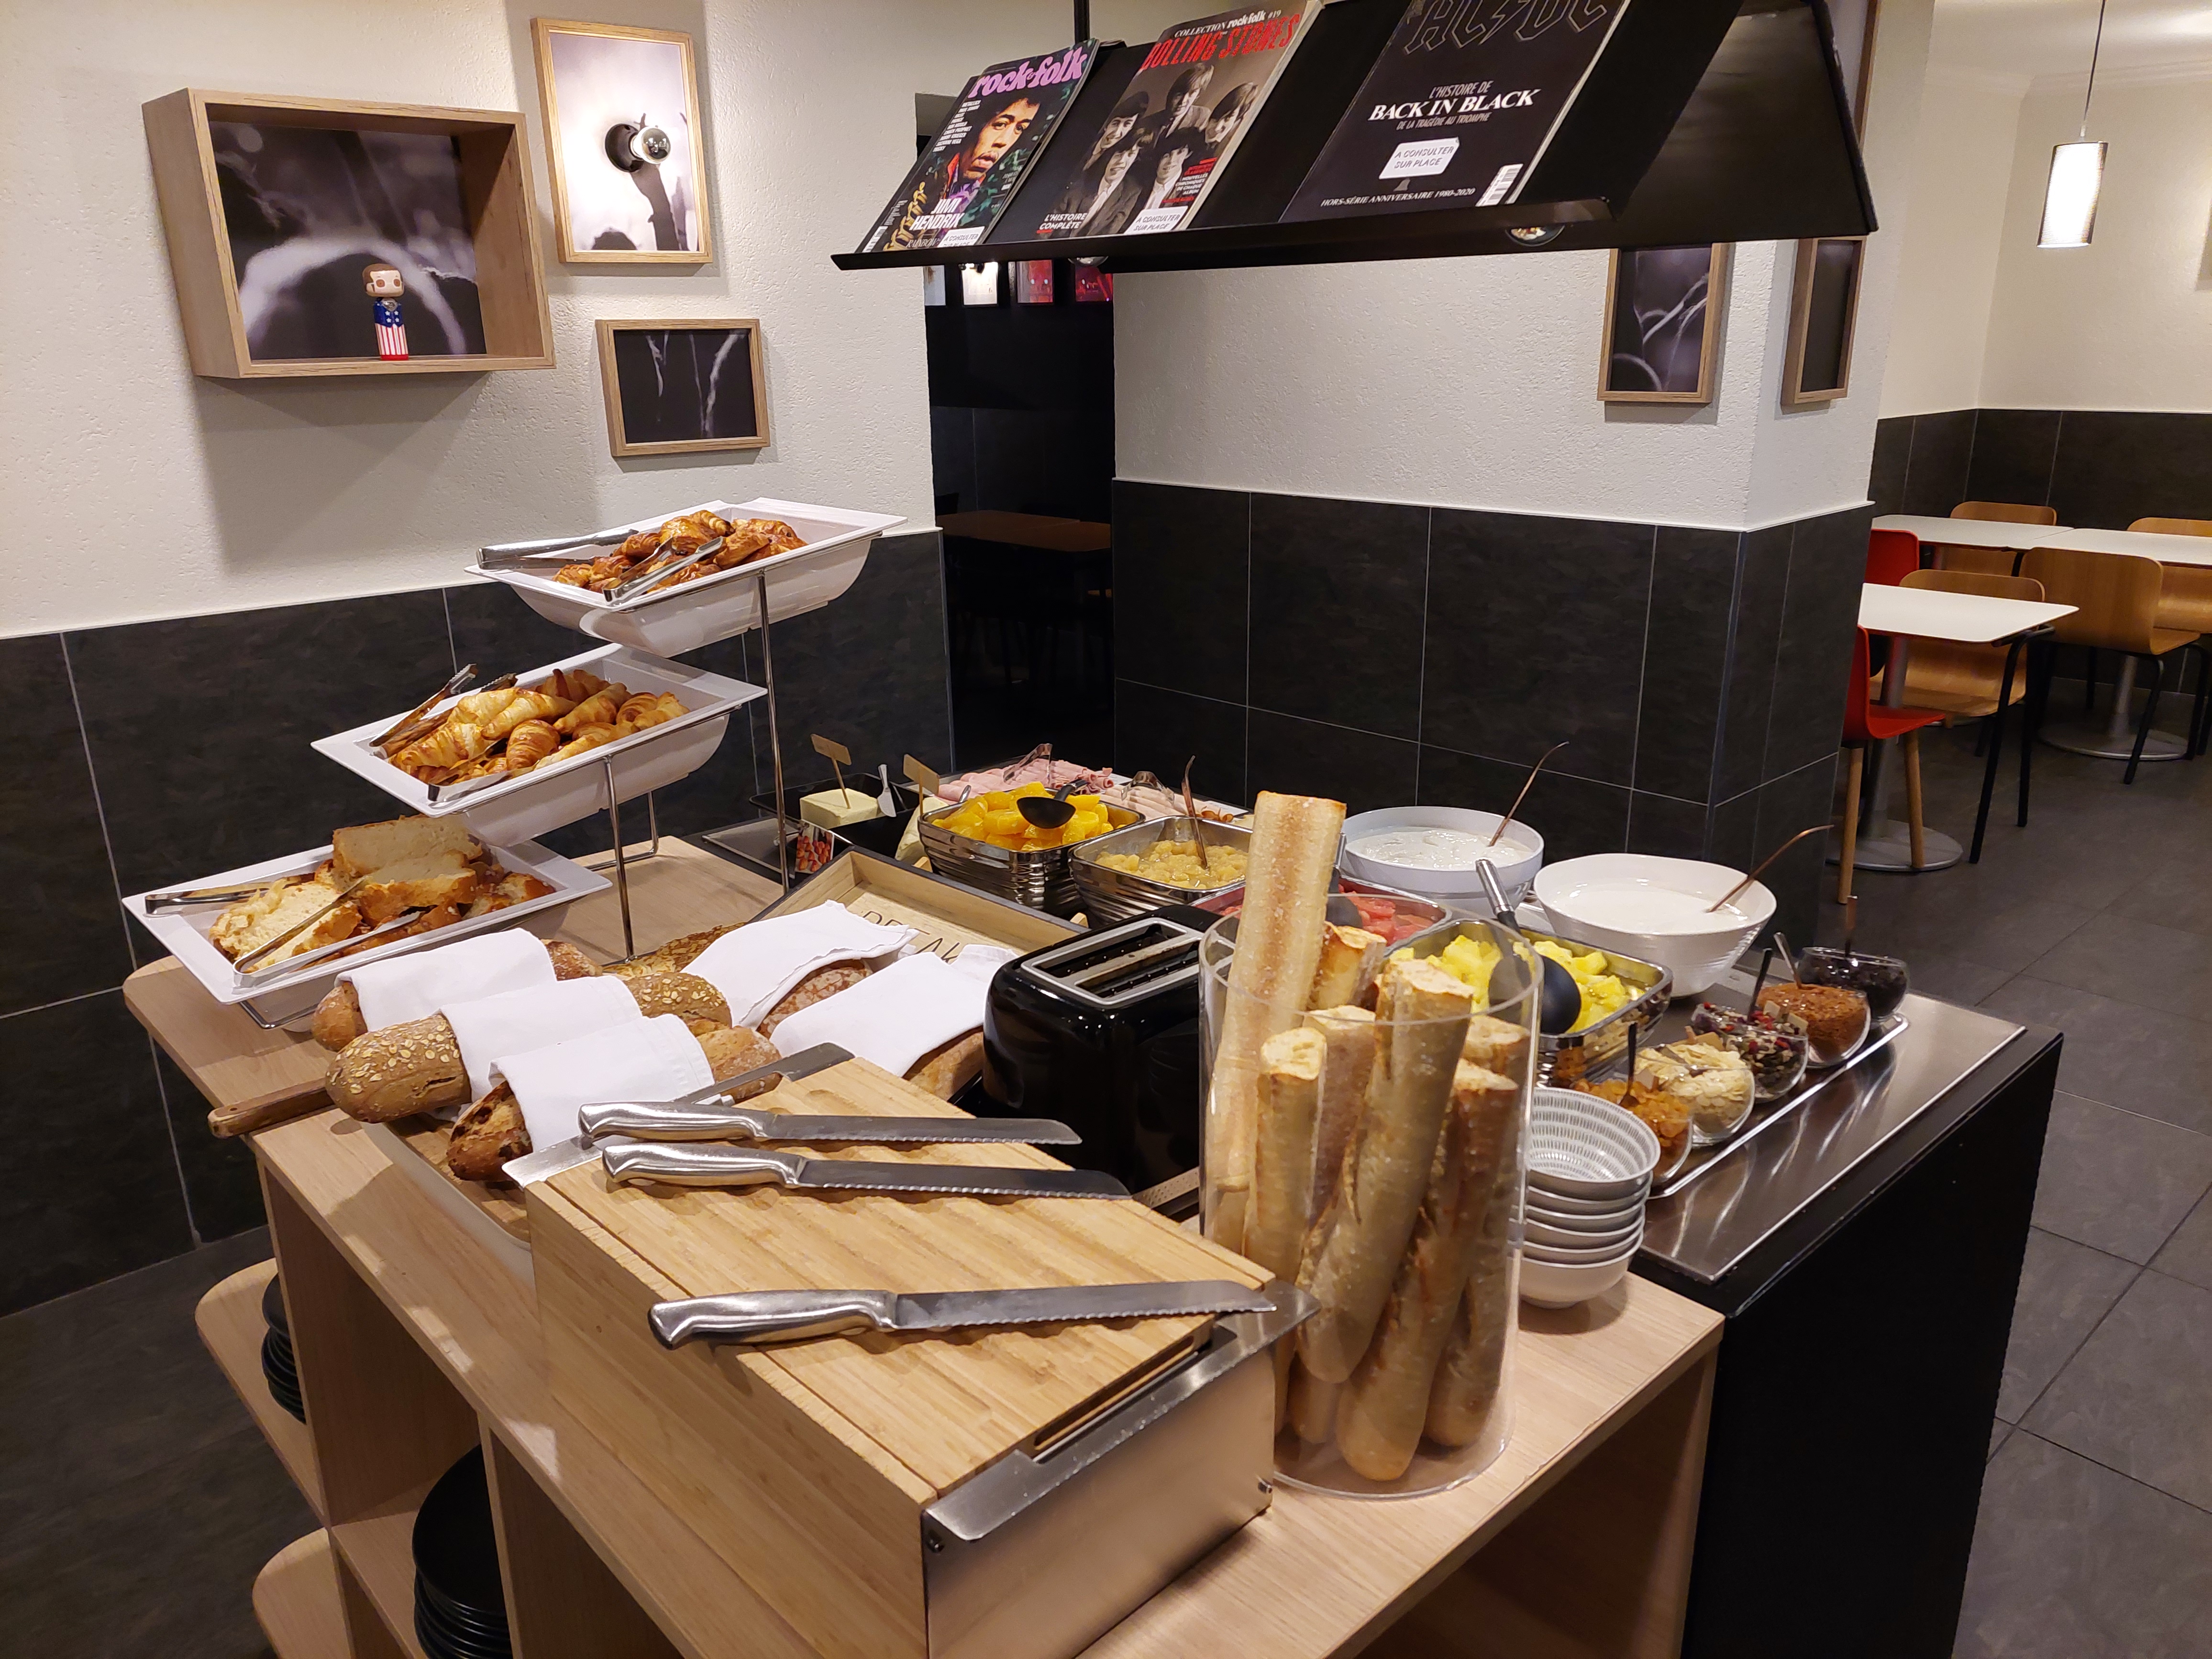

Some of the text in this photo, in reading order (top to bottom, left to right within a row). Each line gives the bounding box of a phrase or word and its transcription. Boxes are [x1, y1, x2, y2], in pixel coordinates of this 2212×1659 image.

[1174, 21, 1228, 38] COLLECTION
[1141, 13, 1300, 70] ROLLING STONES
[1429, 80, 1494, 100] L'HISTOIRE DE
[1368, 88, 1542, 121] BACK IN BLACK
[1396, 111, 1493, 131] DE LA TRAGÉDIE AU TRIOMPHE
[1403, 145, 1454, 158] CONSULTER
[1394, 157, 1444, 169] SUR PLACE
[1182, 172, 1209, 181] NOUVELLES
[1320, 188, 1476, 207] HORS-SÉRIE ANNIVERSAIRE 1980-2020
[930, 198, 962, 214] JIMI
[909, 212, 965, 231] HENDRIX
[1039, 220, 1082, 230] COMPLÈTE
[1044, 212, 1088, 222] L'HISTOIRE
[1142, 213, 1181, 223] CONSULTER
